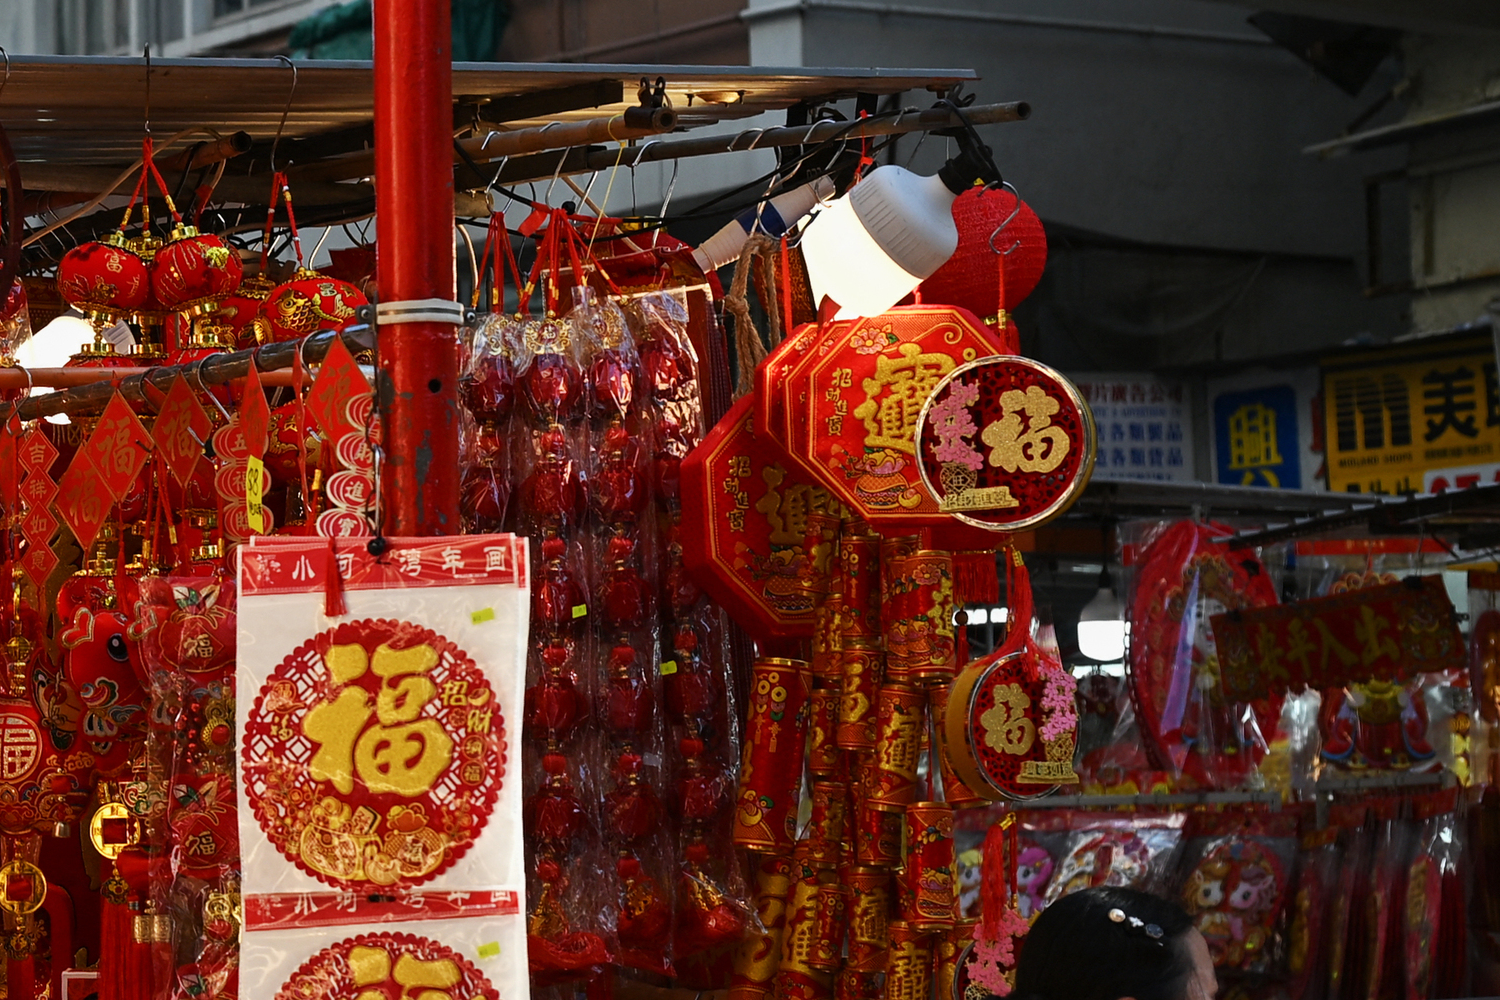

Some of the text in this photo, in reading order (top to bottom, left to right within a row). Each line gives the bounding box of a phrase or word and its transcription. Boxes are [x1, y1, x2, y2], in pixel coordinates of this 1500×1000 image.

[163, 400, 197, 462] 福
[824, 368, 853, 437] 招財進寶
[983, 386, 1071, 474] 福
[96, 414, 138, 479] 福
[1228, 403, 1283, 488] 興
[29, 442, 51, 573] 吉祥如意
[722, 456, 753, 534] 招財進寶
[184, 633, 215, 659] 福
[303, 643, 454, 798] 福
[980, 683, 1036, 756] 福
[185, 830, 217, 857] 福
